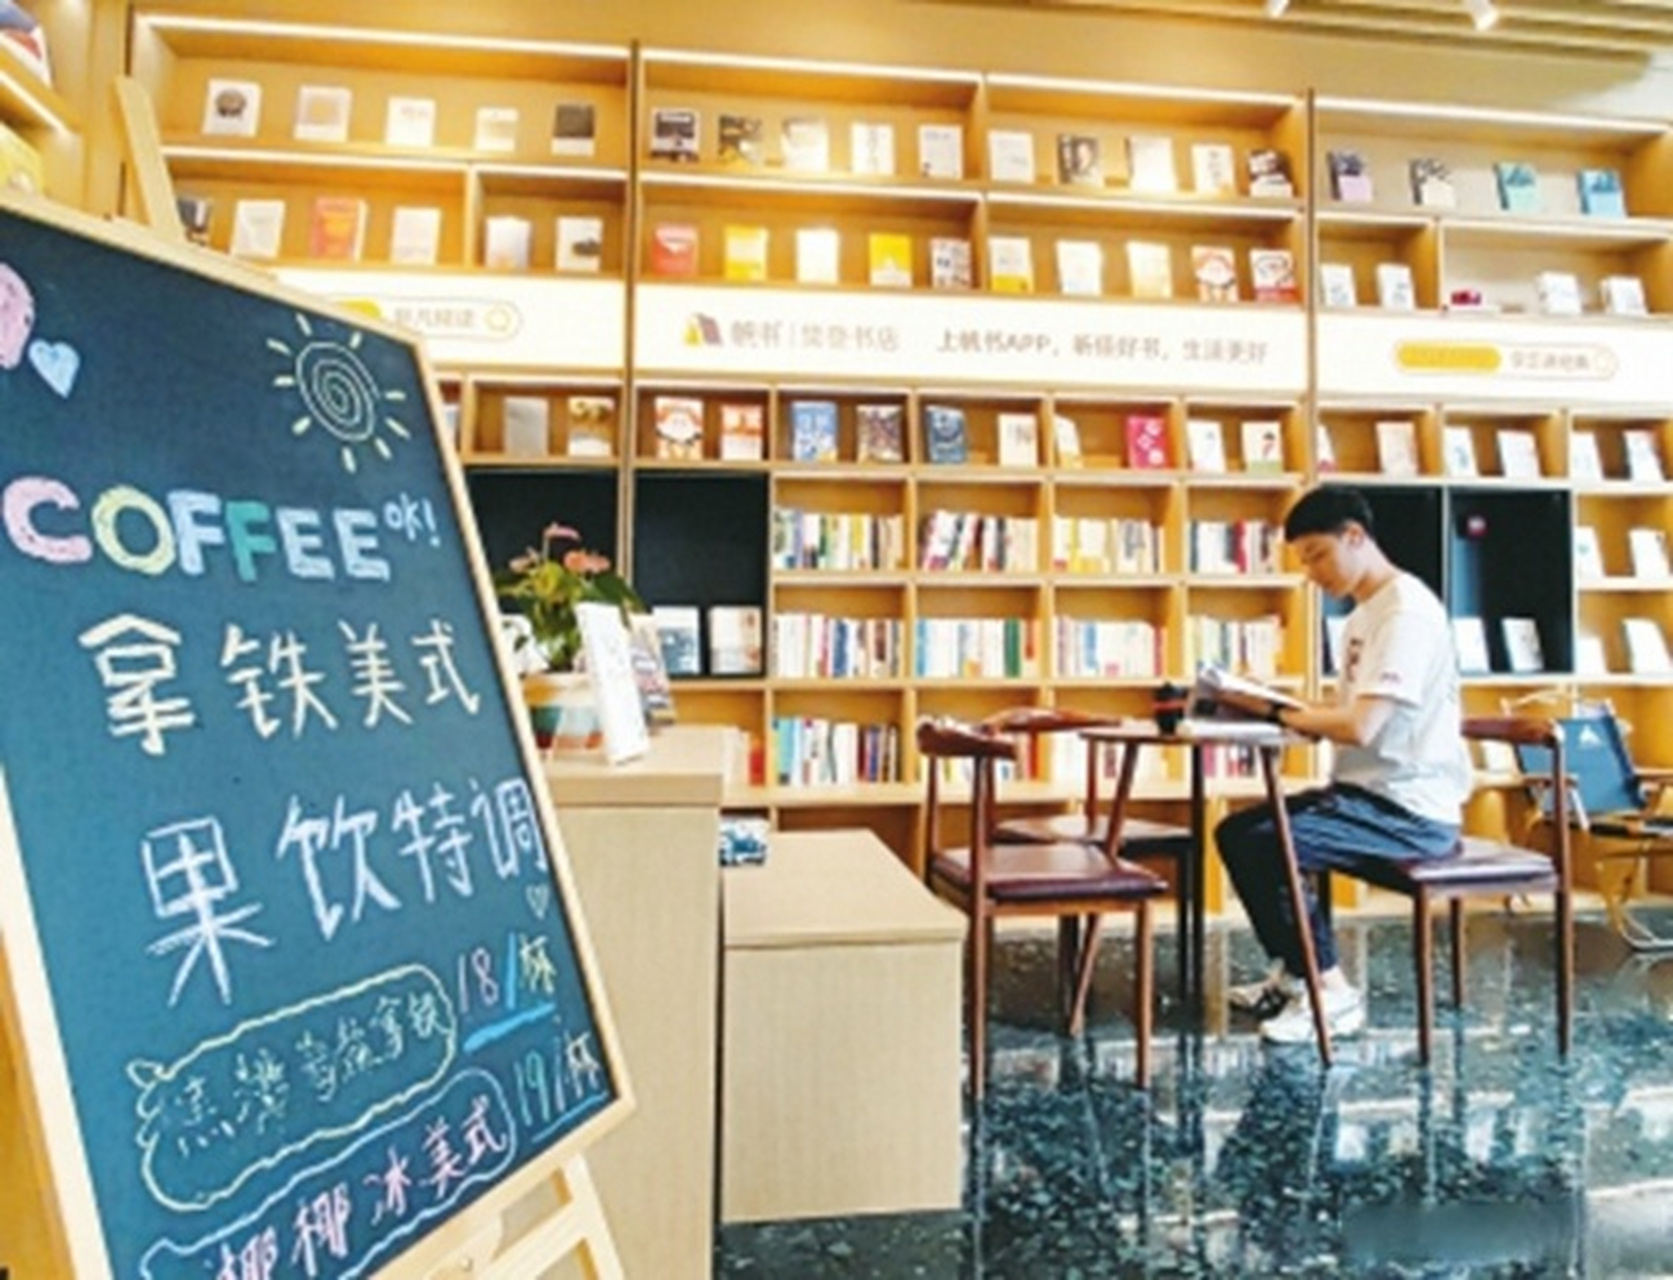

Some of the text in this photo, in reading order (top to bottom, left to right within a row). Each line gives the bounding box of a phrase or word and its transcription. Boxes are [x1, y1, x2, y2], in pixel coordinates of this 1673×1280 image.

[2, 476, 390, 582] COFFEE
[78, 613, 480, 755] 拿铁美式
[141, 777, 549, 1008] 果饮特调
